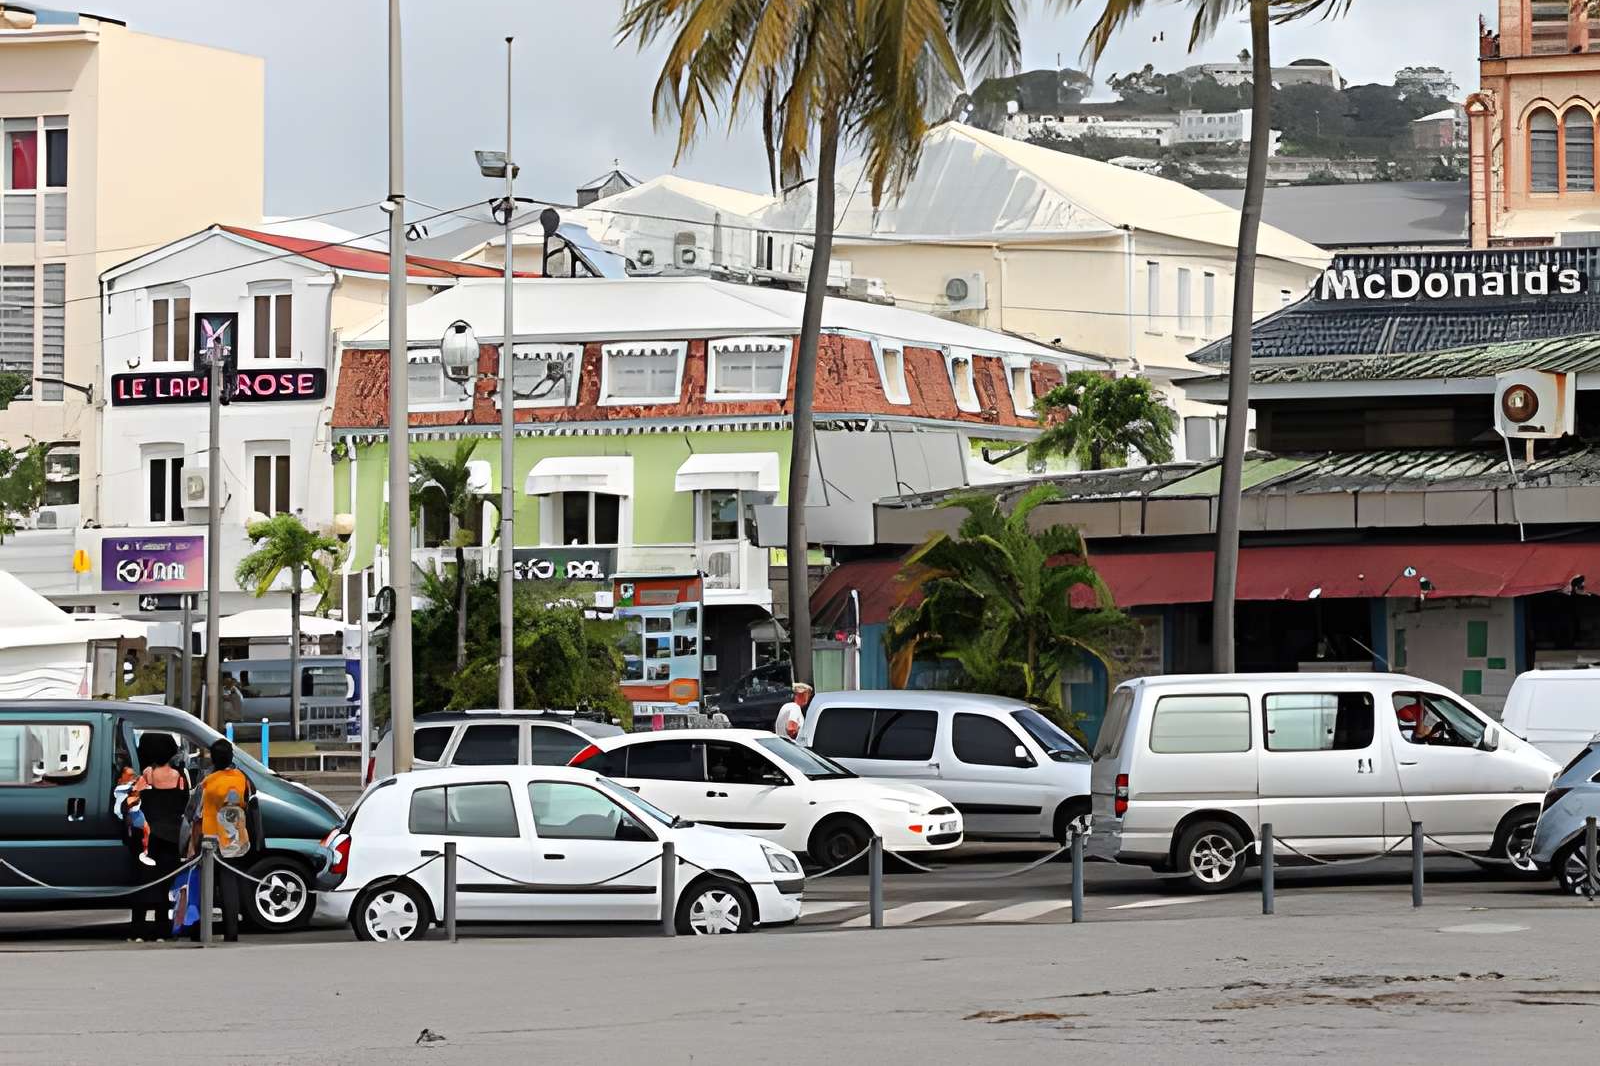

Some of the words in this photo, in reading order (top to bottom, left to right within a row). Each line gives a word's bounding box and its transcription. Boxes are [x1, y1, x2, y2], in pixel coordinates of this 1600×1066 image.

[1321, 264, 1582, 300] McDonald's
[119, 378, 147, 399] LE
[155, 377, 208, 397] LAPI
[236, 373, 315, 395] ROSE
